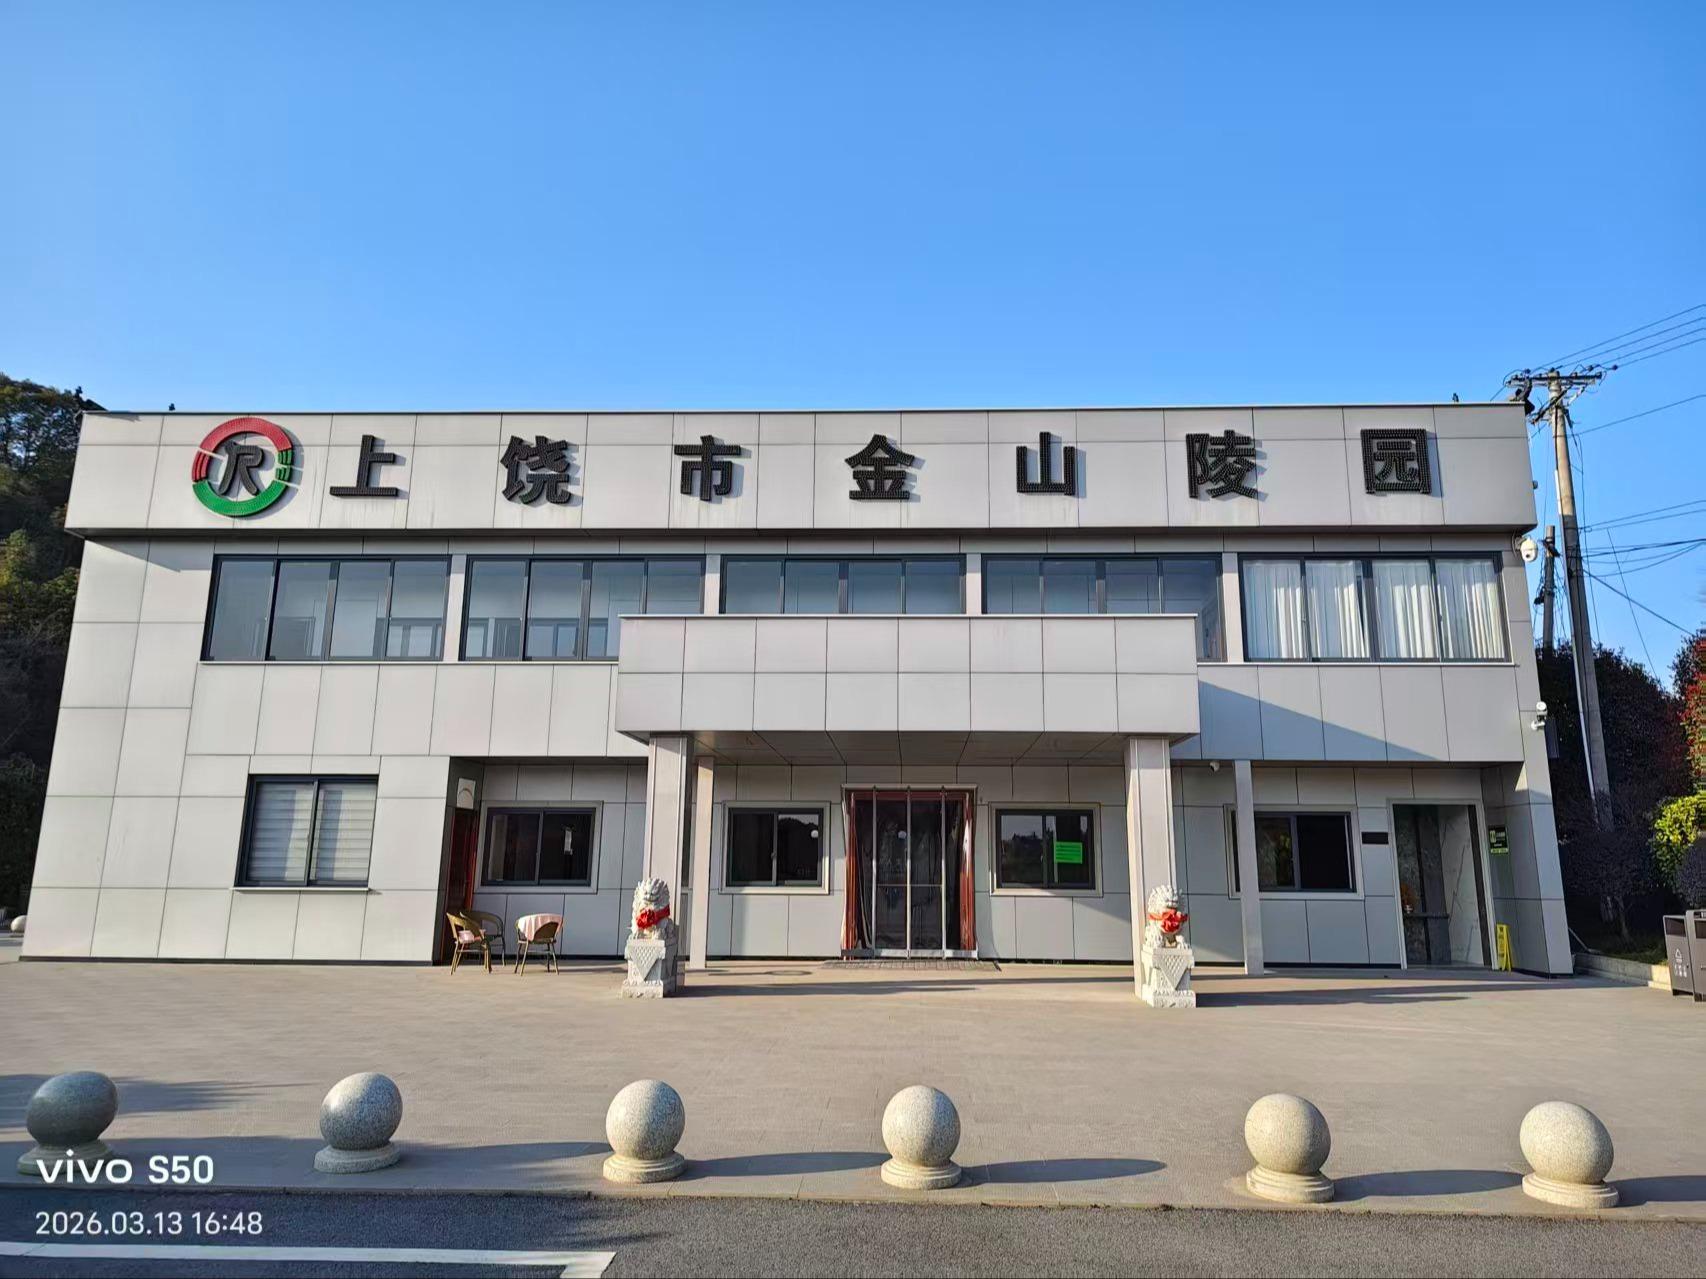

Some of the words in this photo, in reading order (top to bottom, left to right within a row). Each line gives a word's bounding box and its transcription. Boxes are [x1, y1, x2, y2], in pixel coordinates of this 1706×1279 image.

[329, 428, 1432, 504] 上饶市金山陵园
